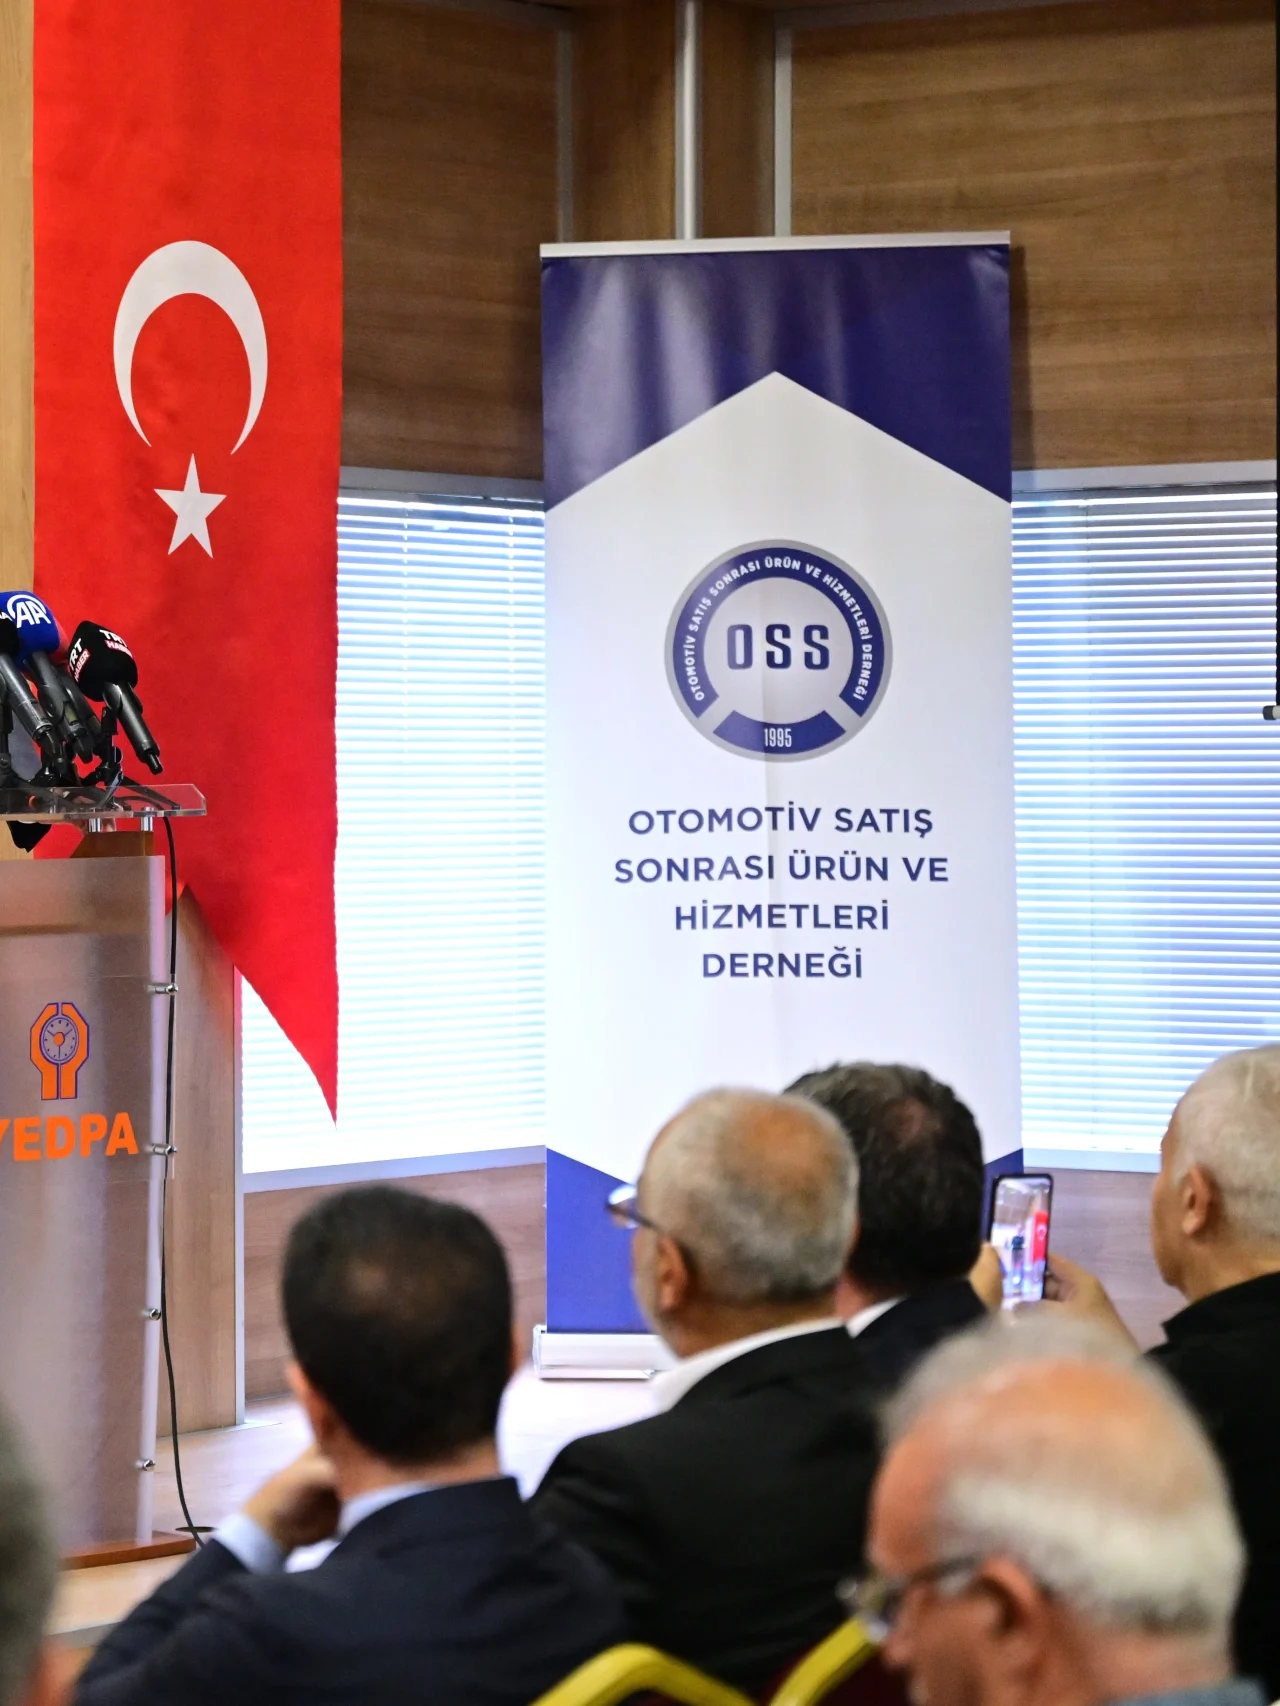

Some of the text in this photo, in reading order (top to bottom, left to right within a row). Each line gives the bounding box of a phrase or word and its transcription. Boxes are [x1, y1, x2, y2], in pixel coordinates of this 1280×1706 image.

[16, 600, 52, 629] AA
[683, 556, 873, 701] OTOMOTİV SATIŞ SONRASI ÜRÜN VE HİZMETLERİ DERNEĞİ
[726, 623, 830, 671] OSS
[763, 727, 793, 749] 1995
[628, 801, 934, 839] OTOMOTİV SATIŞ
[614, 849, 950, 884] SONRASI ÜRÜN VE
[675, 899, 889, 931] HİZMETLERİ
[702, 946, 862, 979] DERNEĞİ
